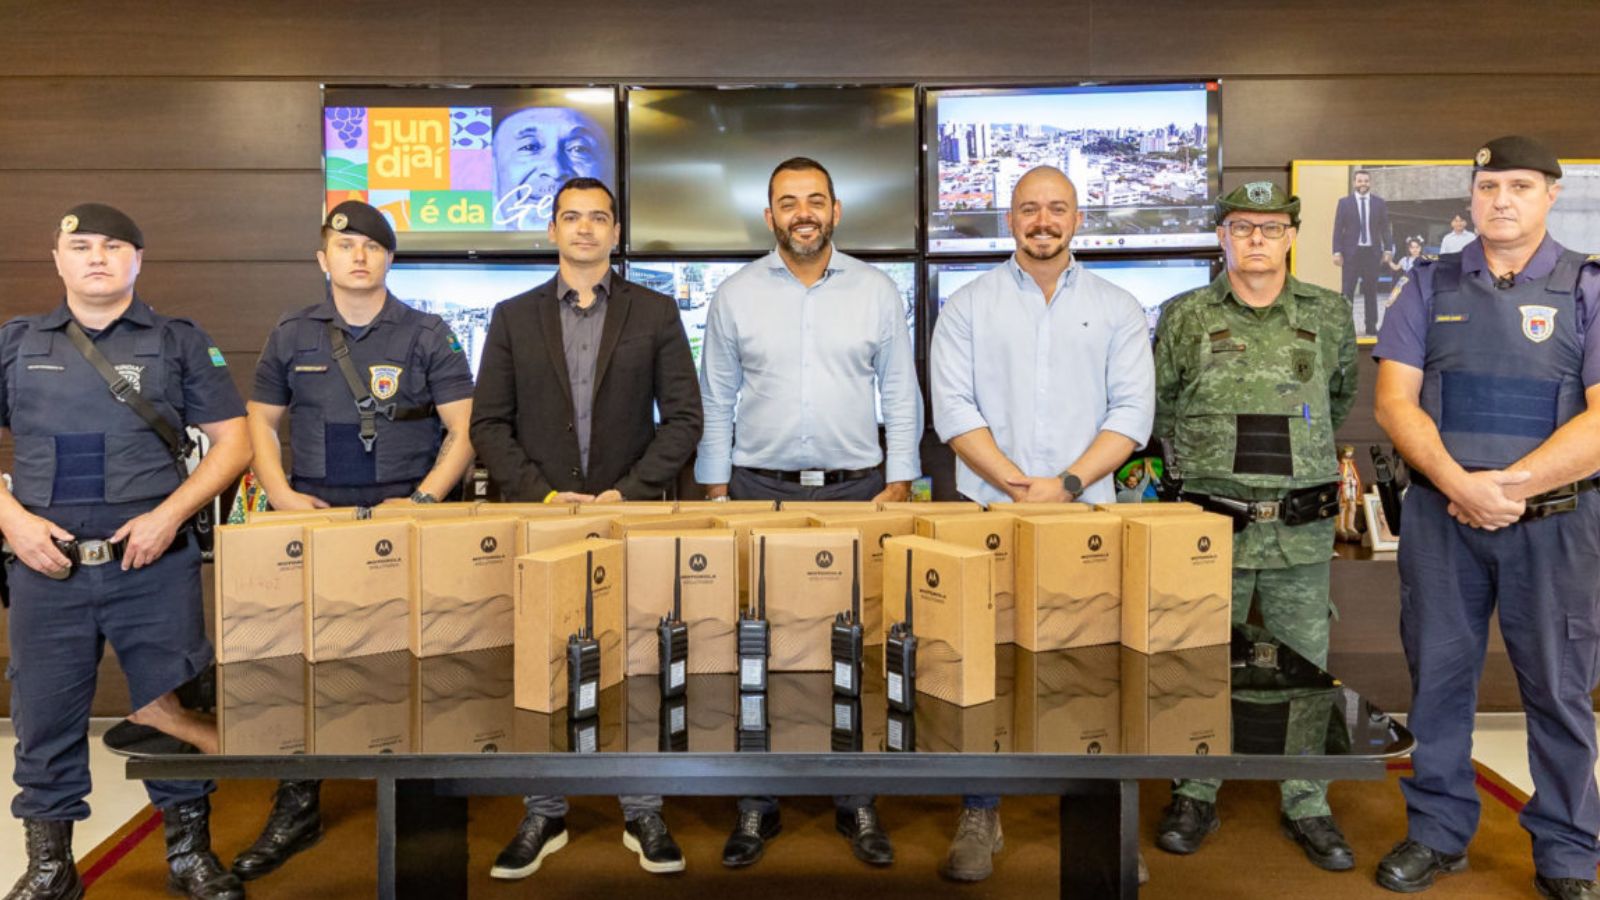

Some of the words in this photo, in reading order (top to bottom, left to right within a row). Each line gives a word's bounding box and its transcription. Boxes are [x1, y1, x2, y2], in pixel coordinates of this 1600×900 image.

[375, 144, 446, 179] diaí
[420, 198, 440, 224] é
[447, 197, 485, 225] da
[492, 183, 555, 231] Ge
